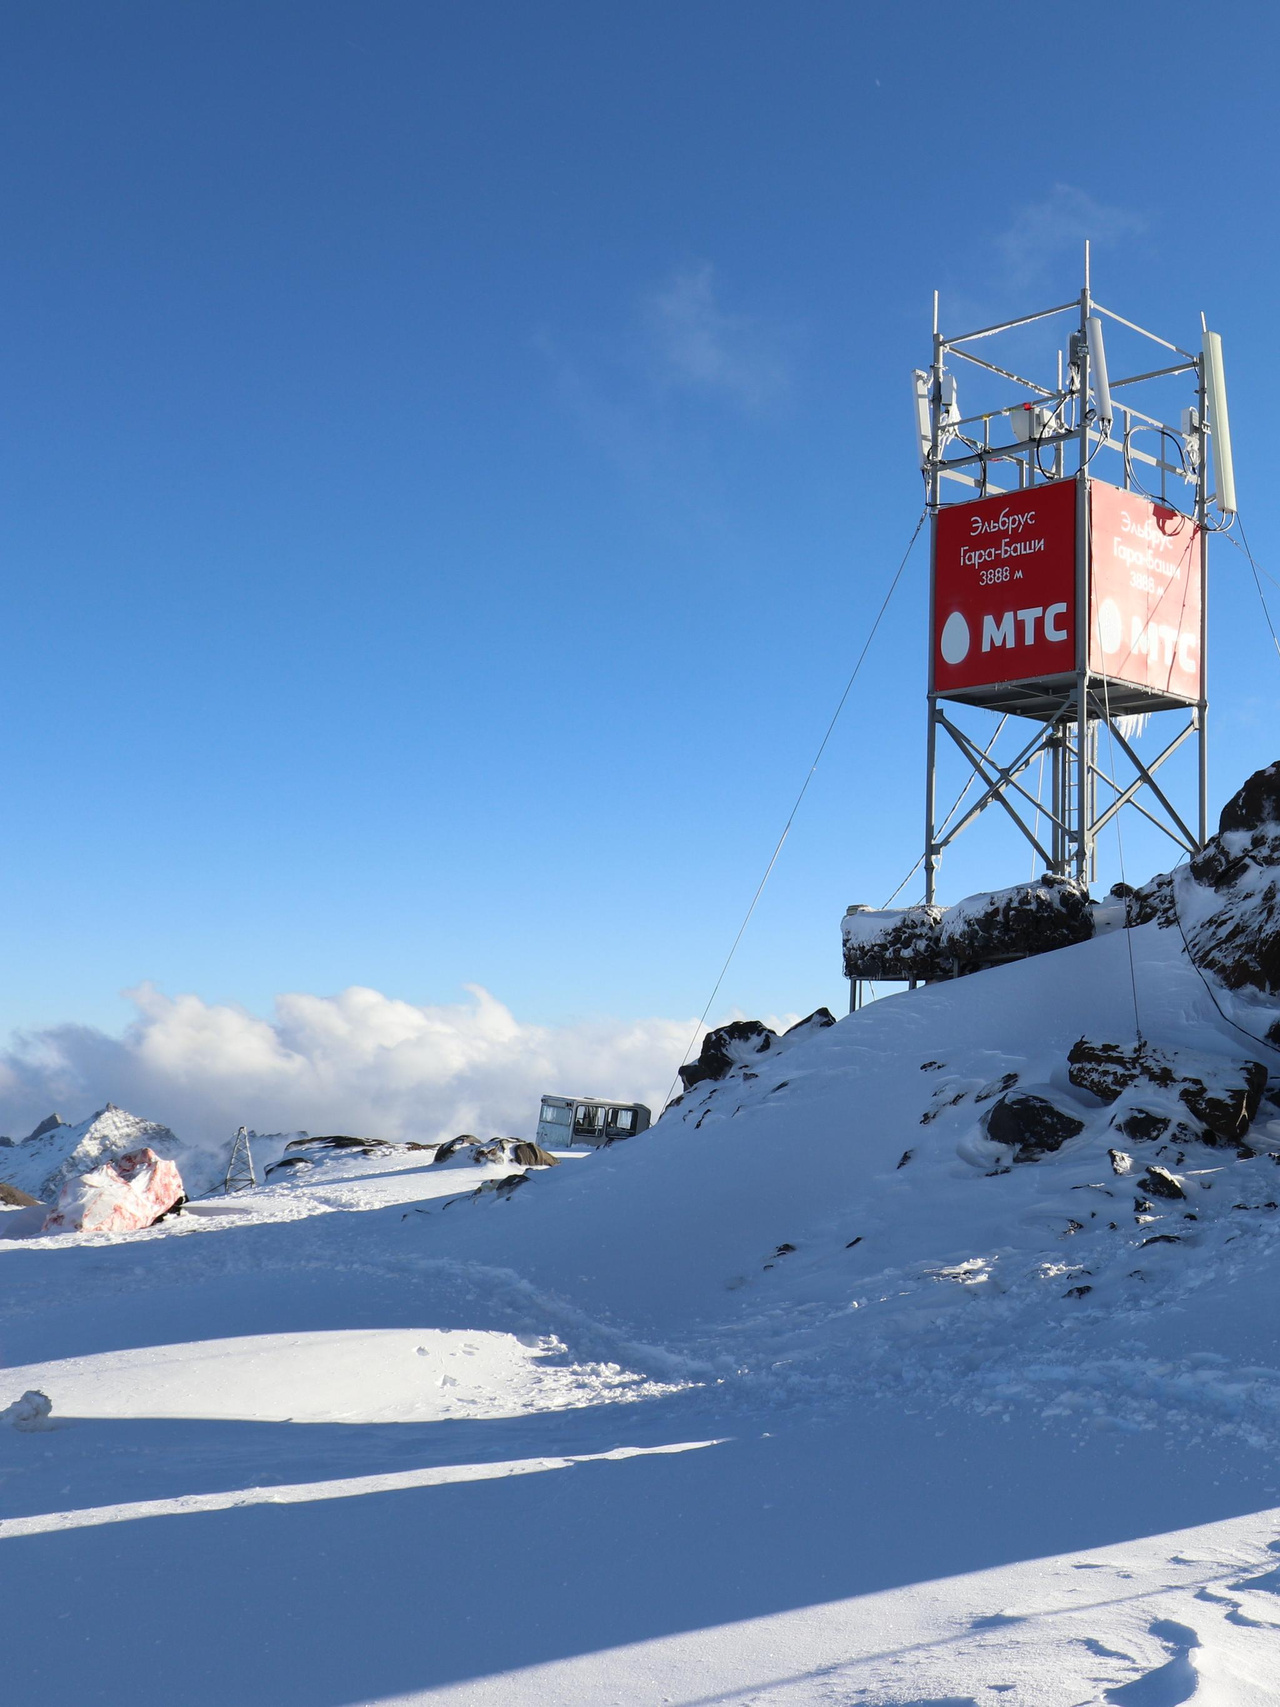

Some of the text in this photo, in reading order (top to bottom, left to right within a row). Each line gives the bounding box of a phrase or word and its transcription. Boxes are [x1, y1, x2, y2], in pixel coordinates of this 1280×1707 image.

[970, 507, 1036, 536] Эльбрус
[960, 538, 1045, 569] Гара-Баши
[1113, 537, 1181, 580] Гара-Баши
[979, 566, 1023, 586] 3888 м
[1130, 571, 1155, 595] 3888
[981, 602, 1068, 653] МТС
[1131, 615, 1196, 673] МТС
